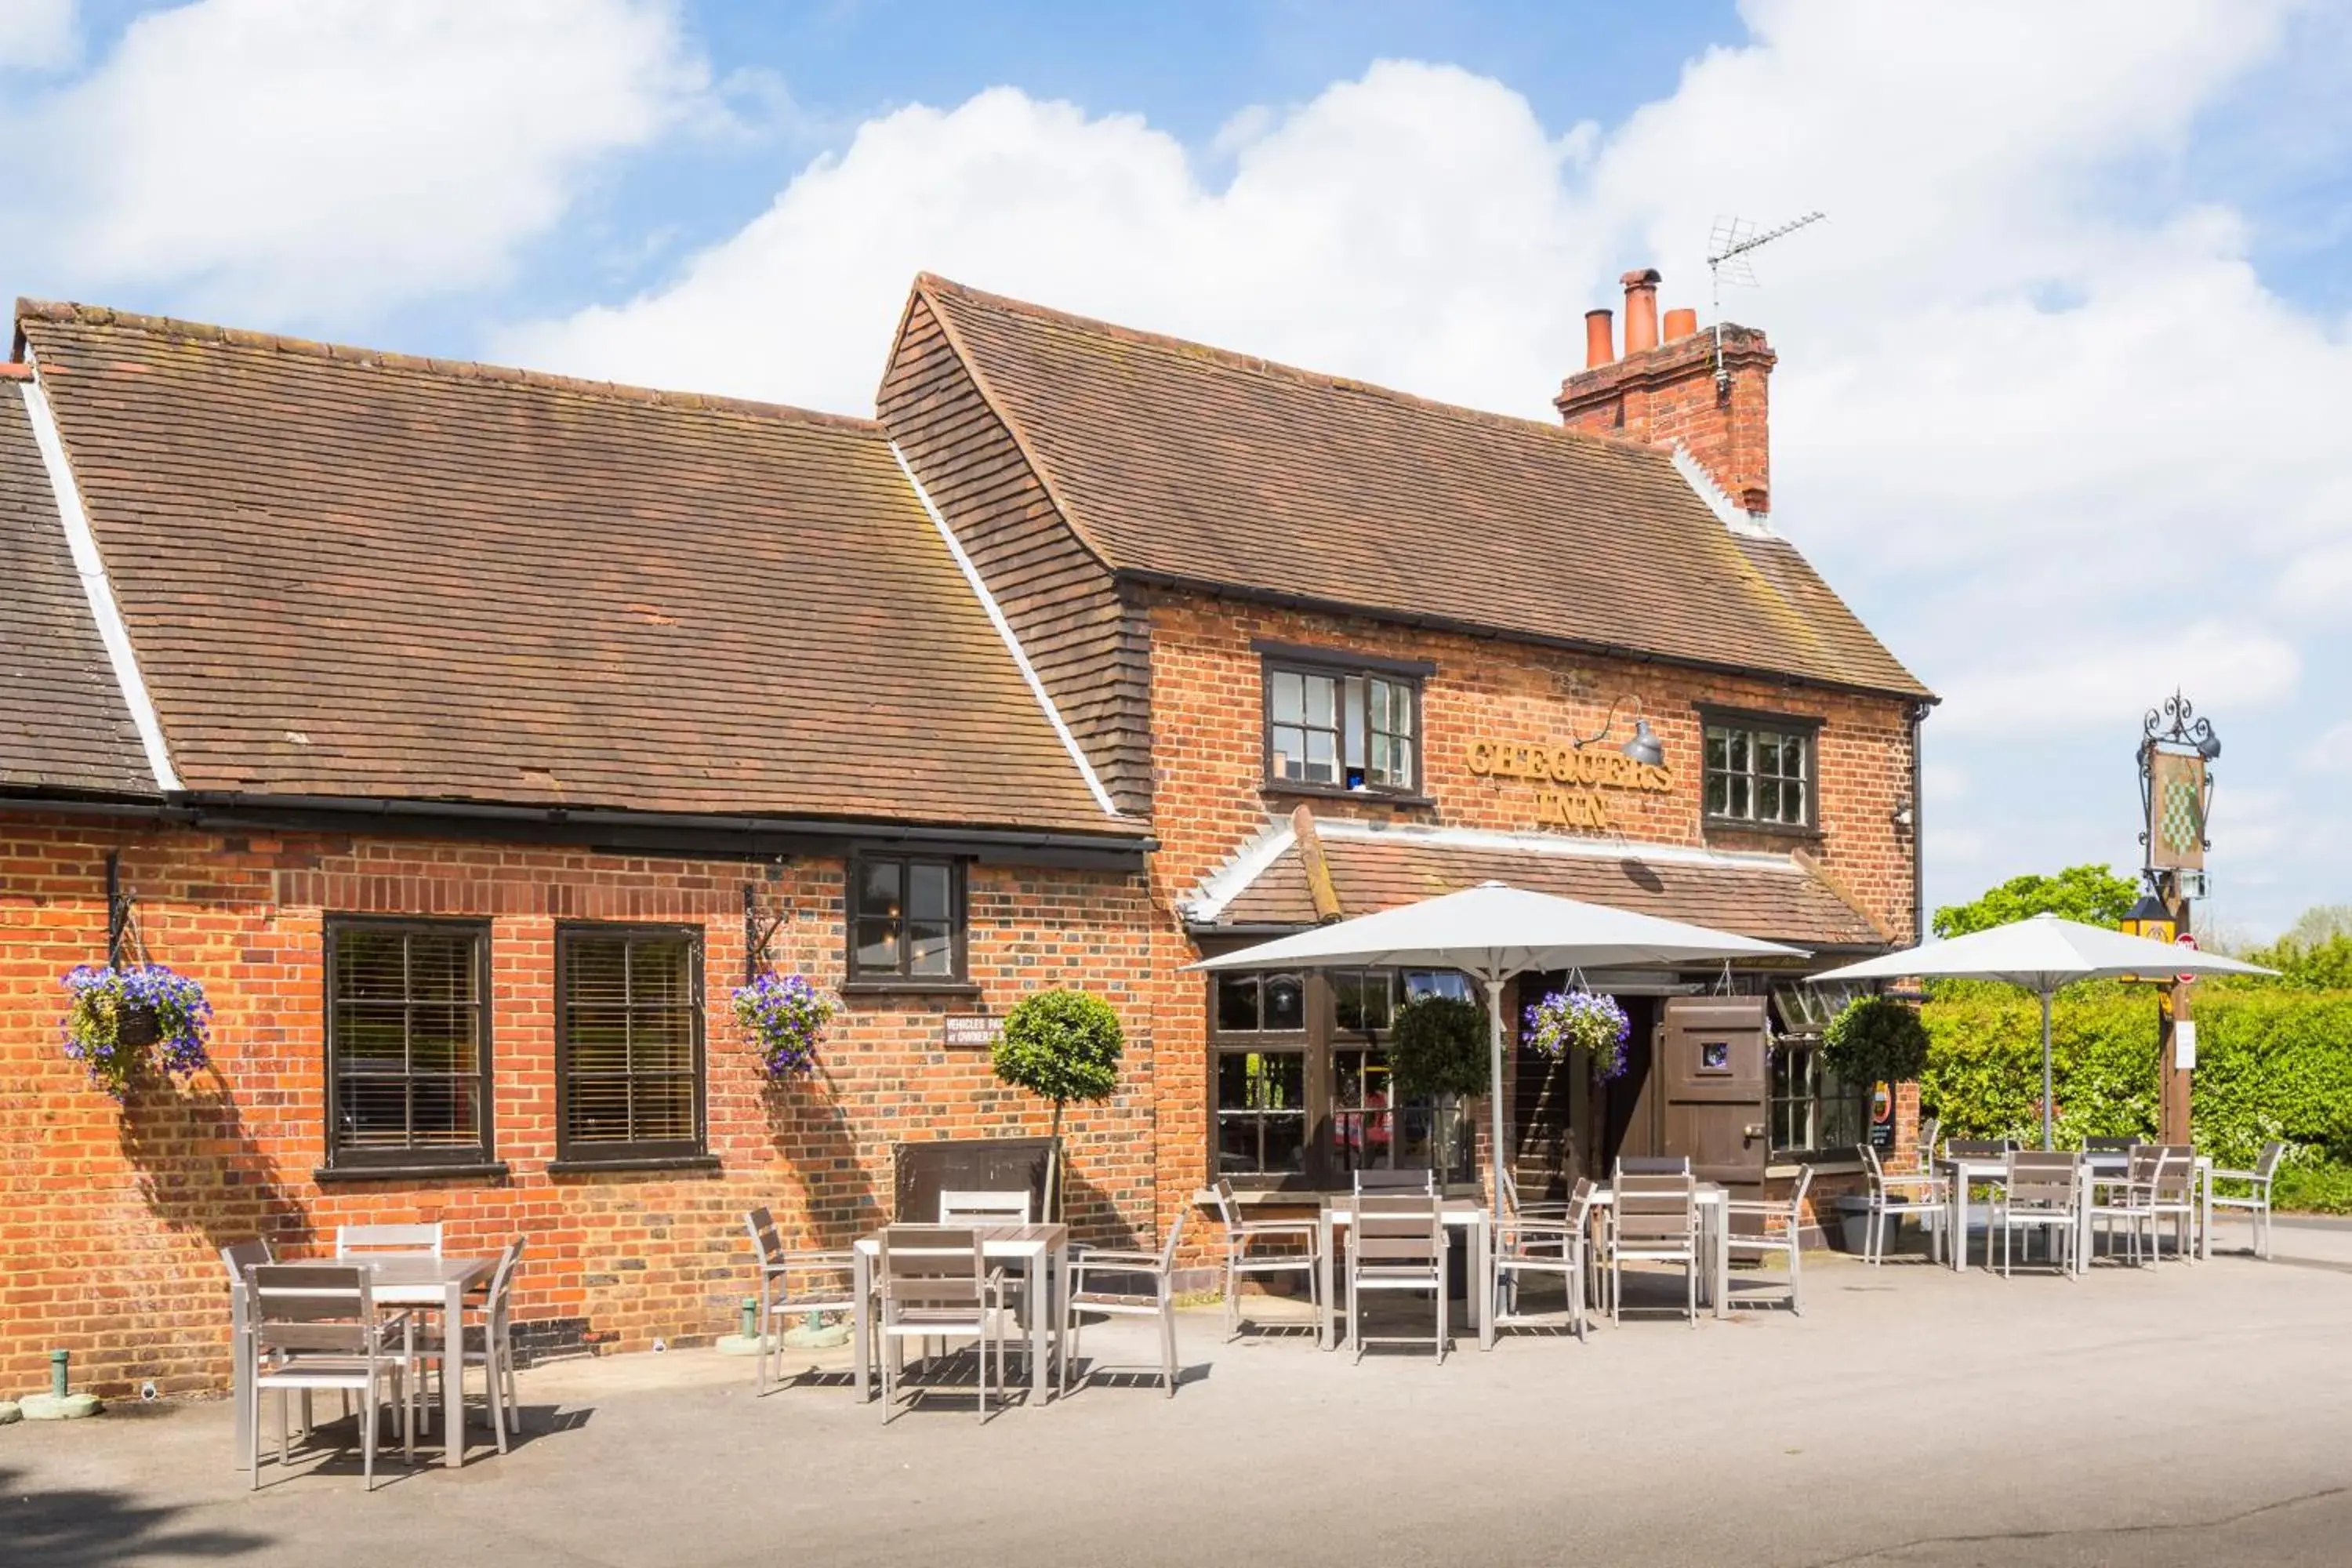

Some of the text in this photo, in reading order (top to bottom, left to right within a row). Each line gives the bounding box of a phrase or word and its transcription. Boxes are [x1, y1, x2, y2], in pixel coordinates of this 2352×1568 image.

[1466, 739, 1674, 792] CHEQUERS
[1535, 789, 1609, 828] INN
[946, 1018, 985, 1029] VEHICLES
